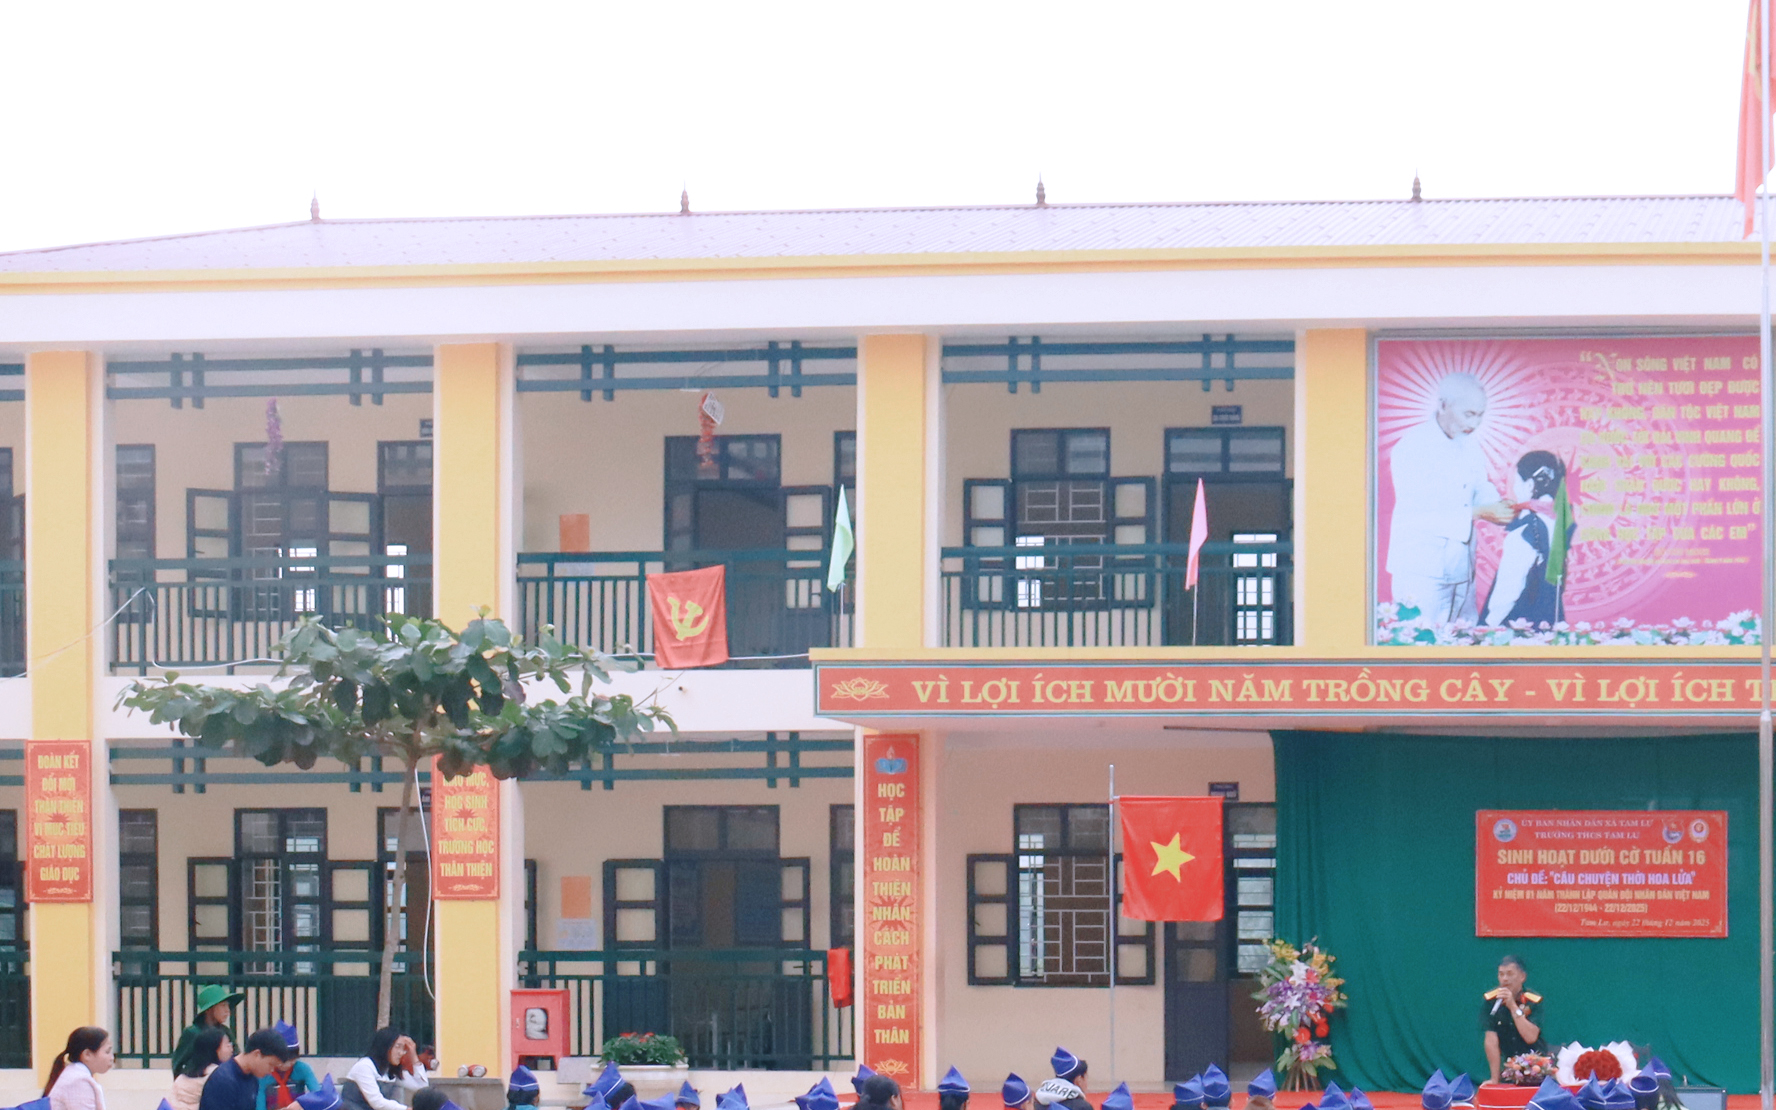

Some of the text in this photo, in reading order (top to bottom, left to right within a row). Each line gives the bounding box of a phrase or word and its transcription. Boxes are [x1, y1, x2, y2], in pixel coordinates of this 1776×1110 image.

[1704, 356, 1731, 370] NAM
[1733, 405, 1761, 418] NAM
[912, 674, 950, 703] VÌ
[961, 678, 1020, 709] LỢI
[1032, 674, 1095, 703] ÍCH
[1104, 672, 1197, 703] MƯỜI
[1208, 673, 1294, 703] NĂM
[1303, 667, 1429, 703] TRỒNG
[1439, 672, 1514, 703] CÂY
[1547, 673, 1587, 702] VÌ
[1597, 676, 1659, 708] LỢI
[1671, 672, 1735, 702] ÍCH
[37, 750, 80, 769] ĐOÀN KẾT
[42, 772, 76, 791] ĐỔI MỚI
[877, 782, 906, 802] HỌC
[445, 795, 487, 810] HỌC SINH
[878, 805, 905, 826] TẬP
[882, 826, 902, 847] ĐỂ
[33, 842, 86, 862] CHẤT LƯỢNG
[438, 838, 494, 857] TRƯỜNG HỌC
[1497, 844, 1706, 868] SINH HOẠT DƯỚI CỜ TUẦN 16
[440, 861, 492, 879] THÂN THIỆN
[873, 853, 911, 872] HOÀN
[40, 864, 80, 884] GIÁO DỤC
[1507, 868, 1529, 885] CHỦ
[1577, 870, 1620, 887] CHUYỆN
[1621, 870, 1646, 885] THỜI
[1648, 873, 1670, 885] HOA
[872, 879, 911, 901] THIỆN
[1582, 888, 1596, 901] LẬP
[1674, 888, 1690, 902] VIỆT
[1691, 890, 1710, 900] NAM
[872, 902, 911, 921] NHÂN
[874, 926, 910, 946] CÁCH
[874, 950, 909, 970] PHÁT
[872, 973, 911, 995] TRIỂN
[877, 999, 905, 1020] BẢN
[874, 1023, 909, 1044] THÂN
